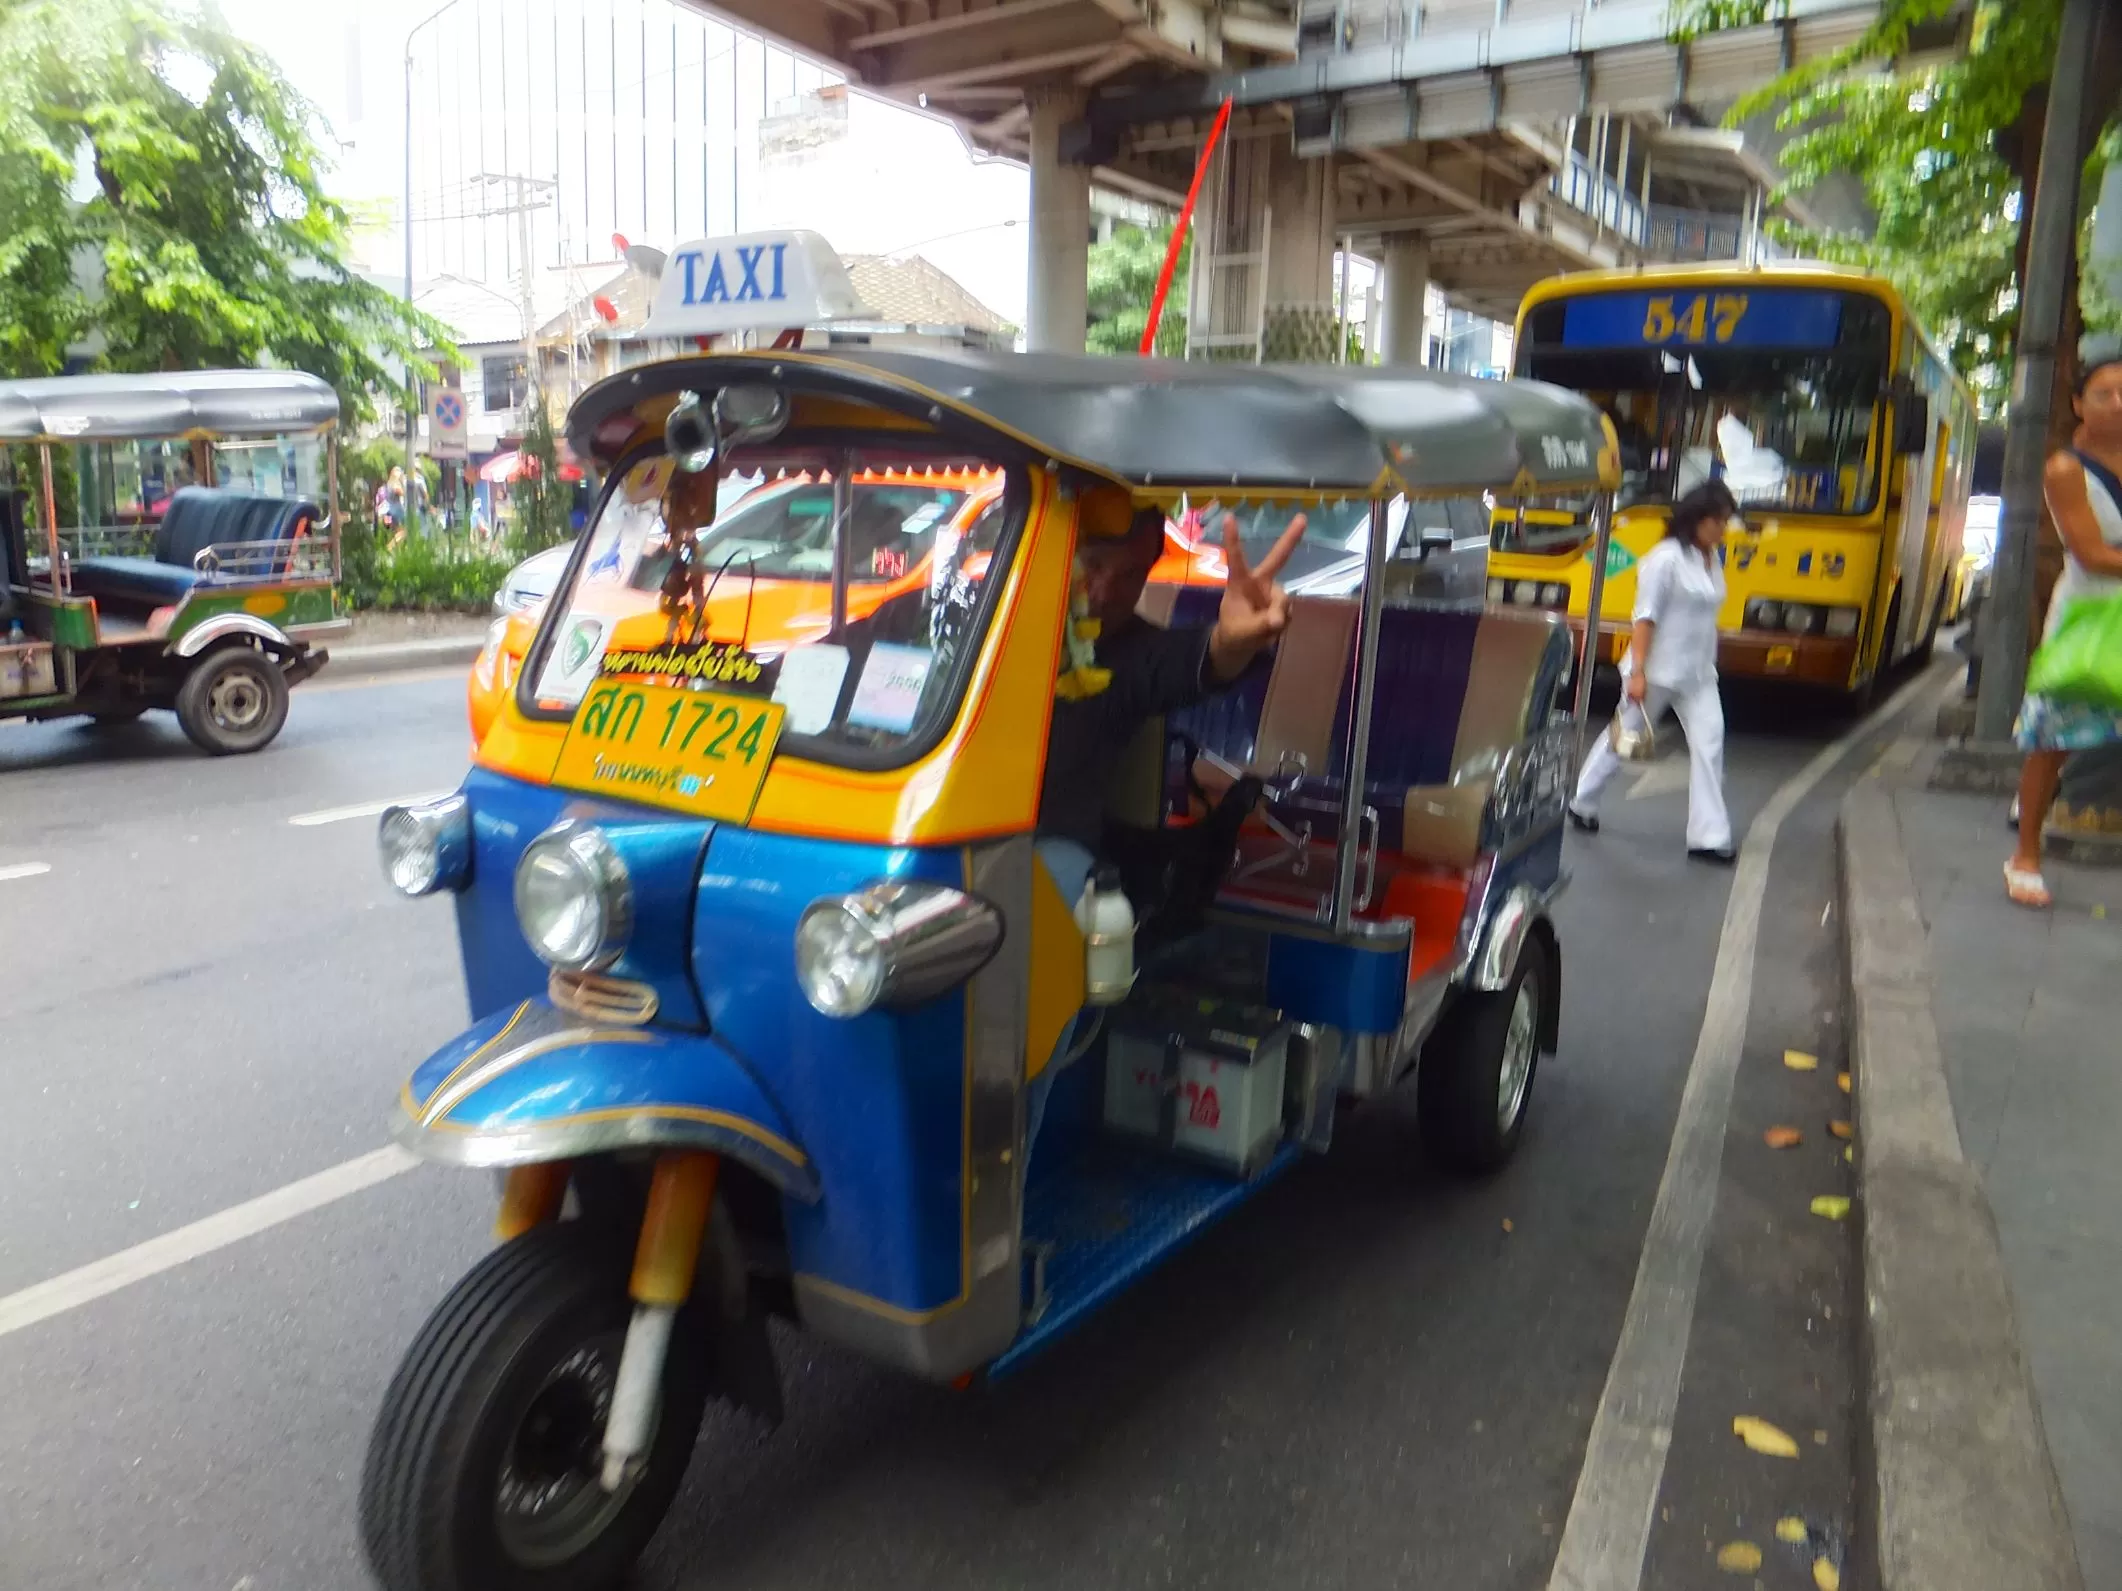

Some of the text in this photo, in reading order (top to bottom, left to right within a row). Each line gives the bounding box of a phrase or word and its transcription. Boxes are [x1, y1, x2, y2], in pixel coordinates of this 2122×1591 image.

[675, 243, 788, 306] TAXI
[1643, 294, 1748, 344] 547
[582, 684, 772, 767] สก 1724
